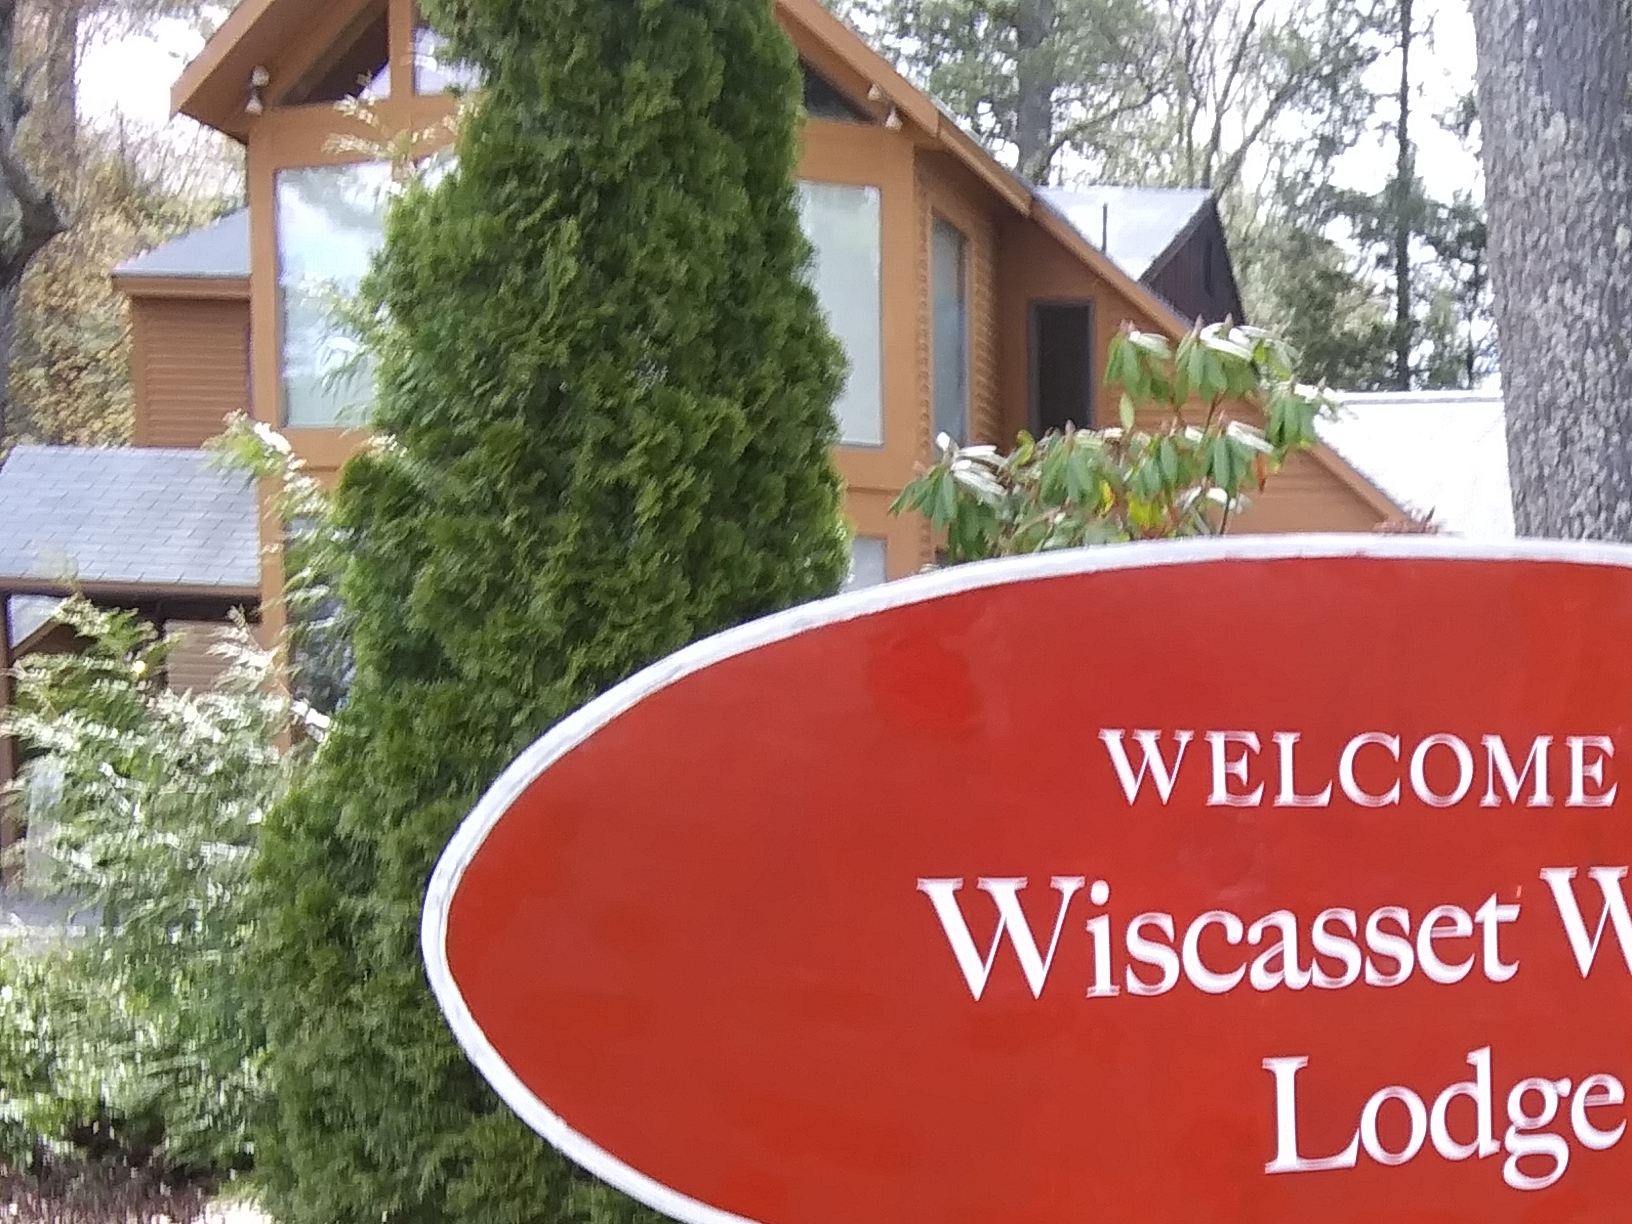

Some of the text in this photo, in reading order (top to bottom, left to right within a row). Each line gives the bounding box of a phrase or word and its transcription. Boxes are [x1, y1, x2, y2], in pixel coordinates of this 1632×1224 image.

[1097, 727, 1619, 808] WELCOME
[915, 875, 1522, 1003] Wiscasset
[1262, 1045, 1628, 1191] Lodge
